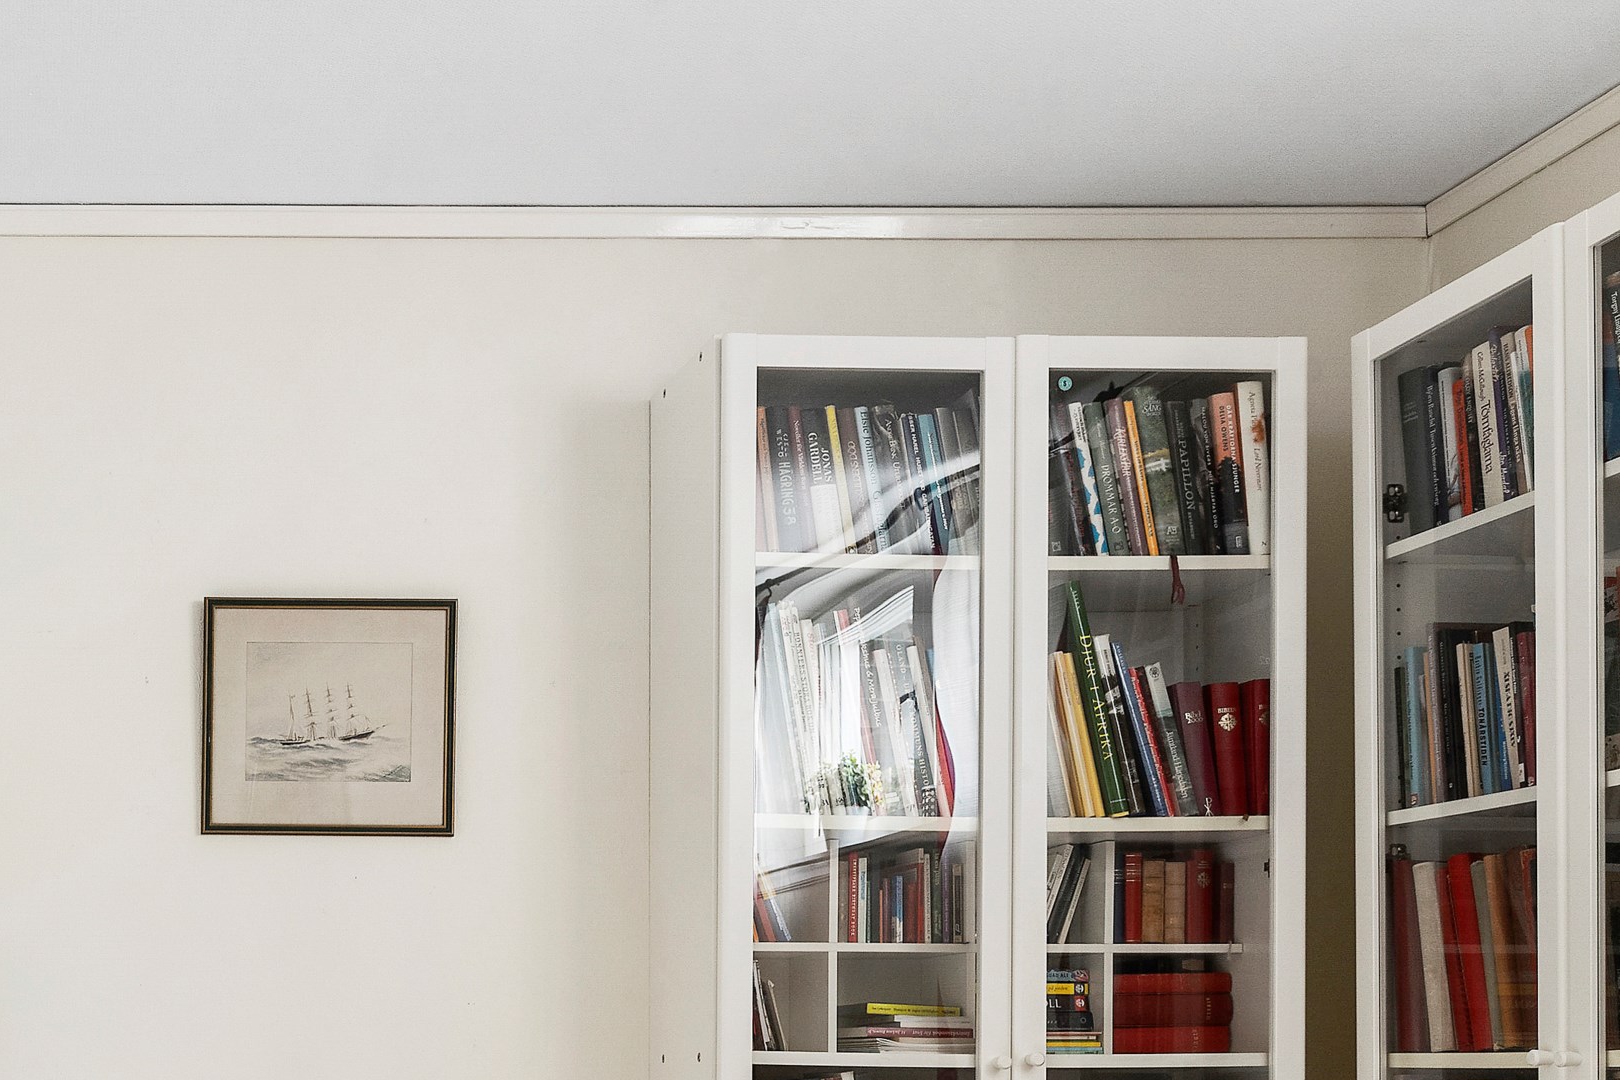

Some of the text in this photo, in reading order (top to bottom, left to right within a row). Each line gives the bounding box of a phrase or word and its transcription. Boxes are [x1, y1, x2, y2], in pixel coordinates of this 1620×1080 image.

[1610, 292, 1619, 314] Torgny
[860, 411, 870, 434] Elsie
[807, 432, 823, 484] GARDELL
[821, 447, 833, 483] JONAS
[862, 435, 876, 485] Johansson
[1178, 439, 1195, 511] PAPILLON
[1231, 463, 1240, 493] SJUNGER
[1078, 634, 1096, 678] DJUR
[1091, 699, 1113, 761] AFRIKA
